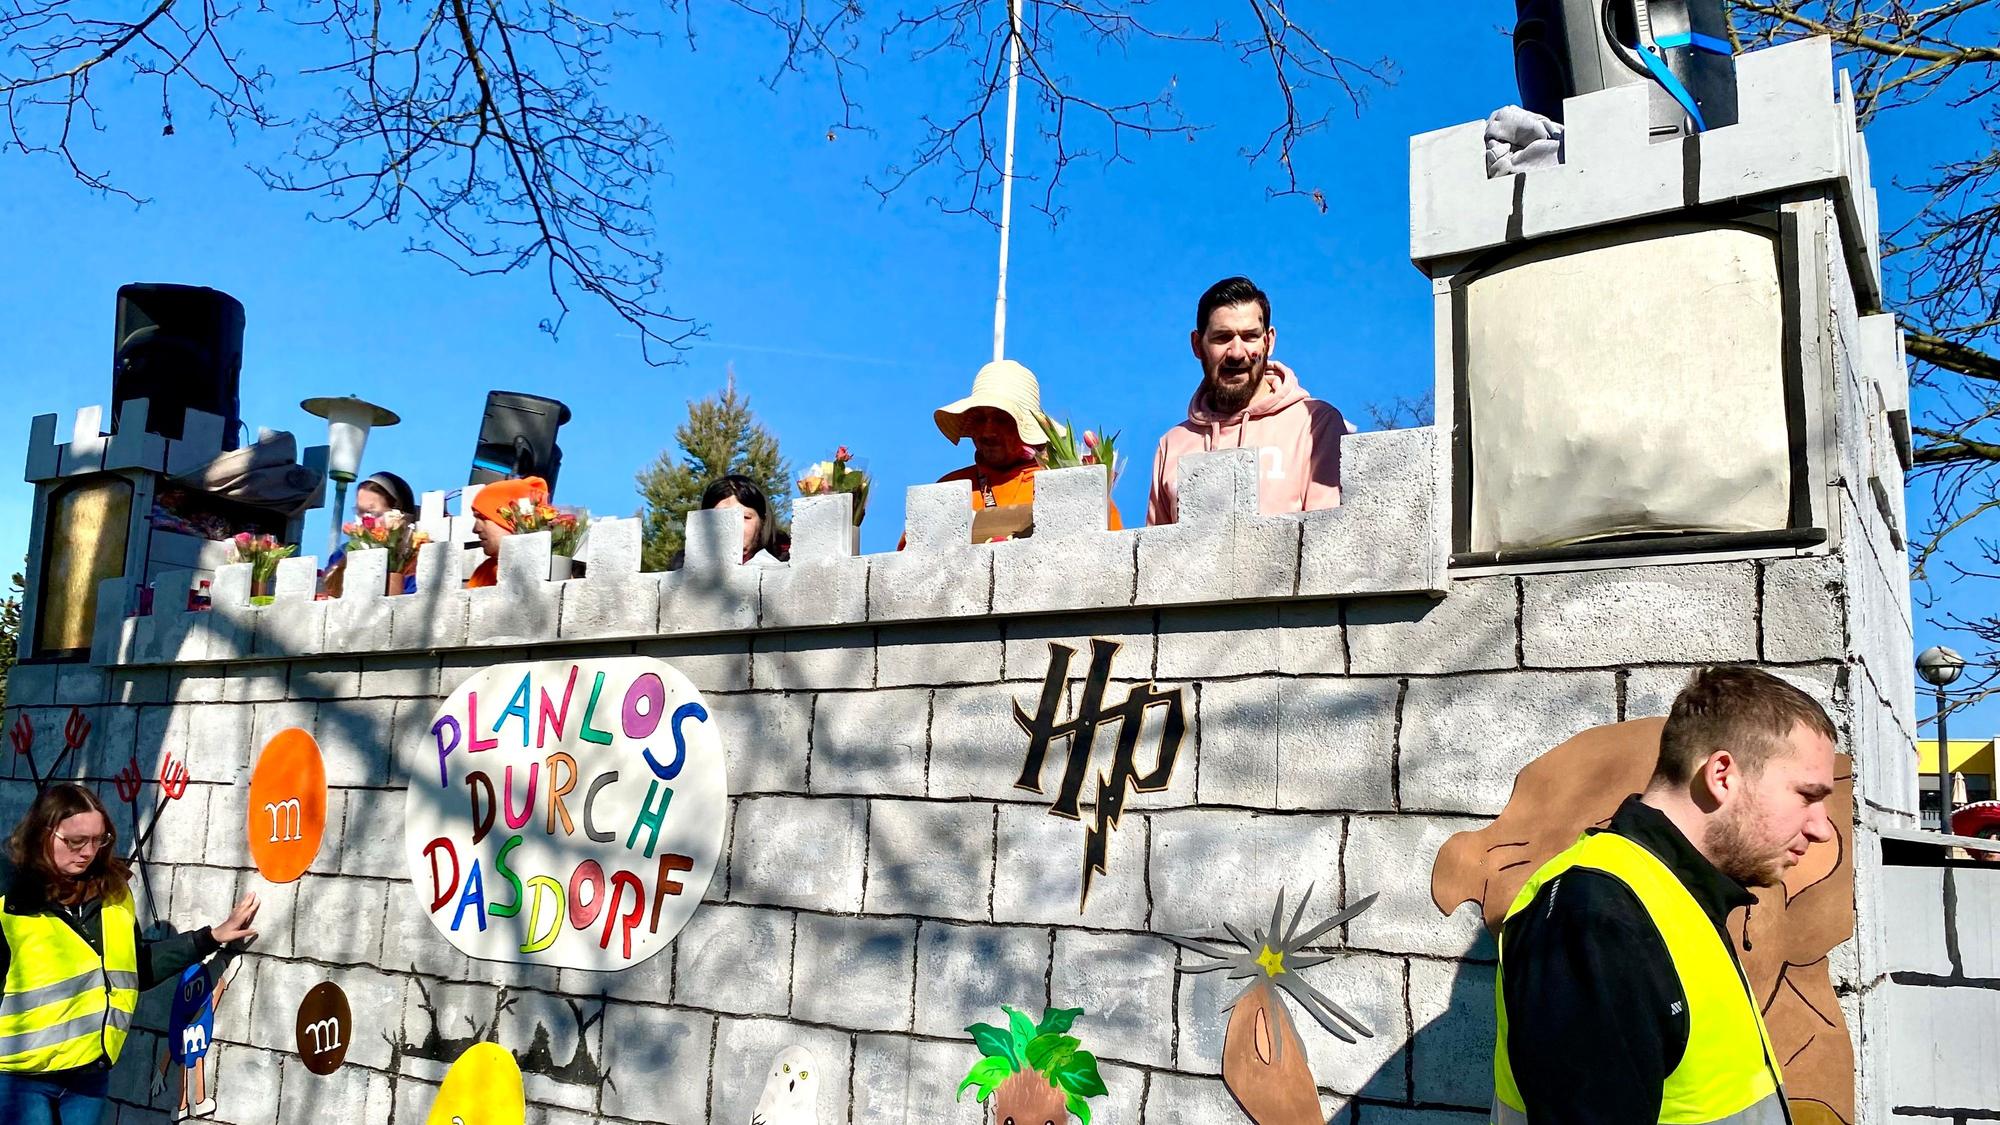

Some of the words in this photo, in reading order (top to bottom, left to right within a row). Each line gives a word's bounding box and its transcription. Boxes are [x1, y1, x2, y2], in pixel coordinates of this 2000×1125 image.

[431, 665, 708, 788] PLANLOS
[264, 798, 302, 842] m
[465, 751, 674, 859] DURCH
[183, 1024, 207, 1055] m
[305, 1016, 342, 1055] m
